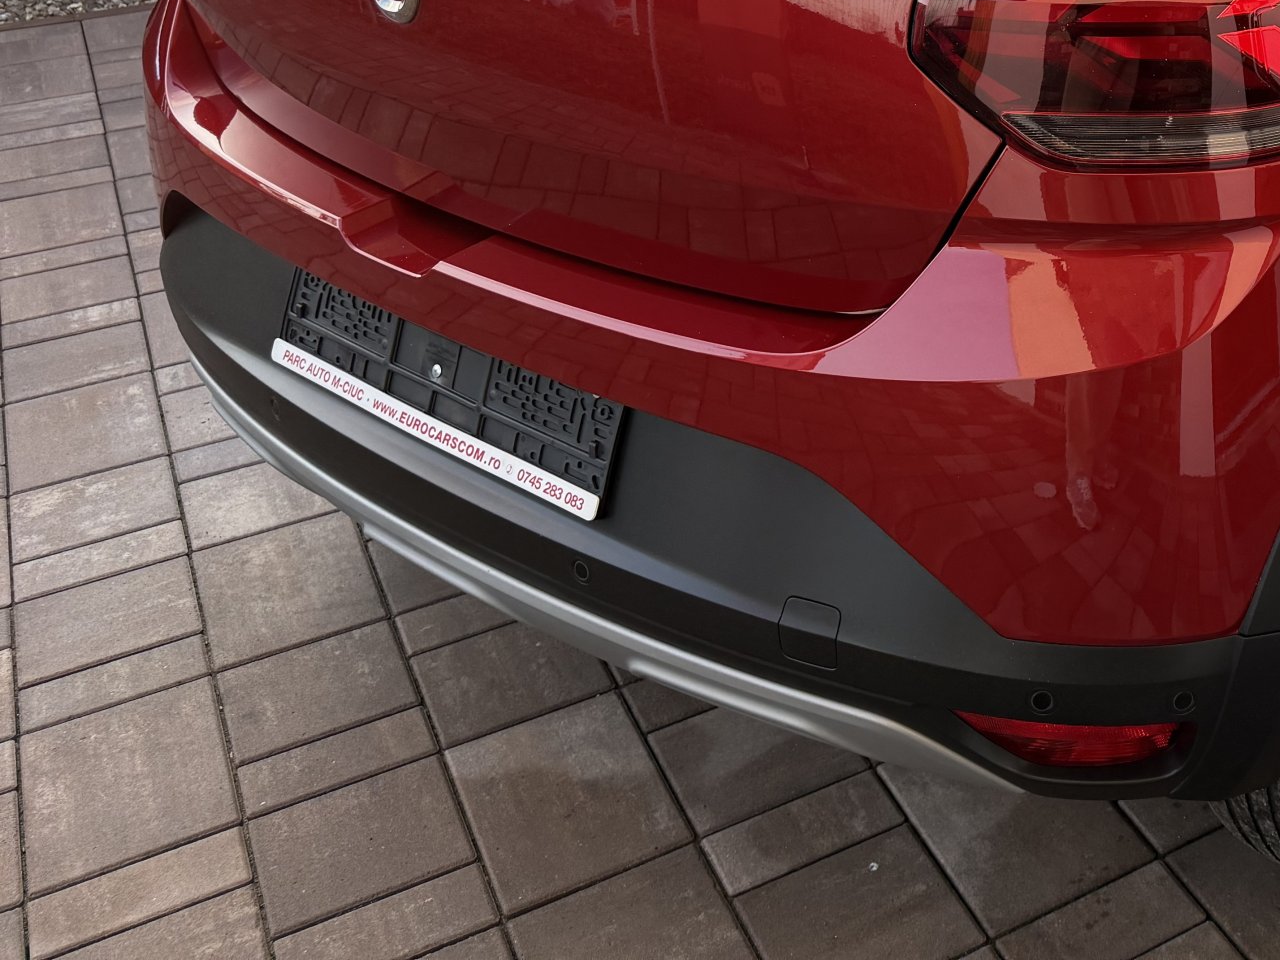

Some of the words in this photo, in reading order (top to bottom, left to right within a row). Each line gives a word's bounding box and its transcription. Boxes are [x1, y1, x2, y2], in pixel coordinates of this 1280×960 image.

[282, 349, 307, 370] PARC
[306, 362, 331, 383] AUTO
[331, 375, 365, 401] M-CIUC
[517, 468, 543, 490] 0745
[542, 481, 564, 500] 283
[564, 491, 585, 511] 083
